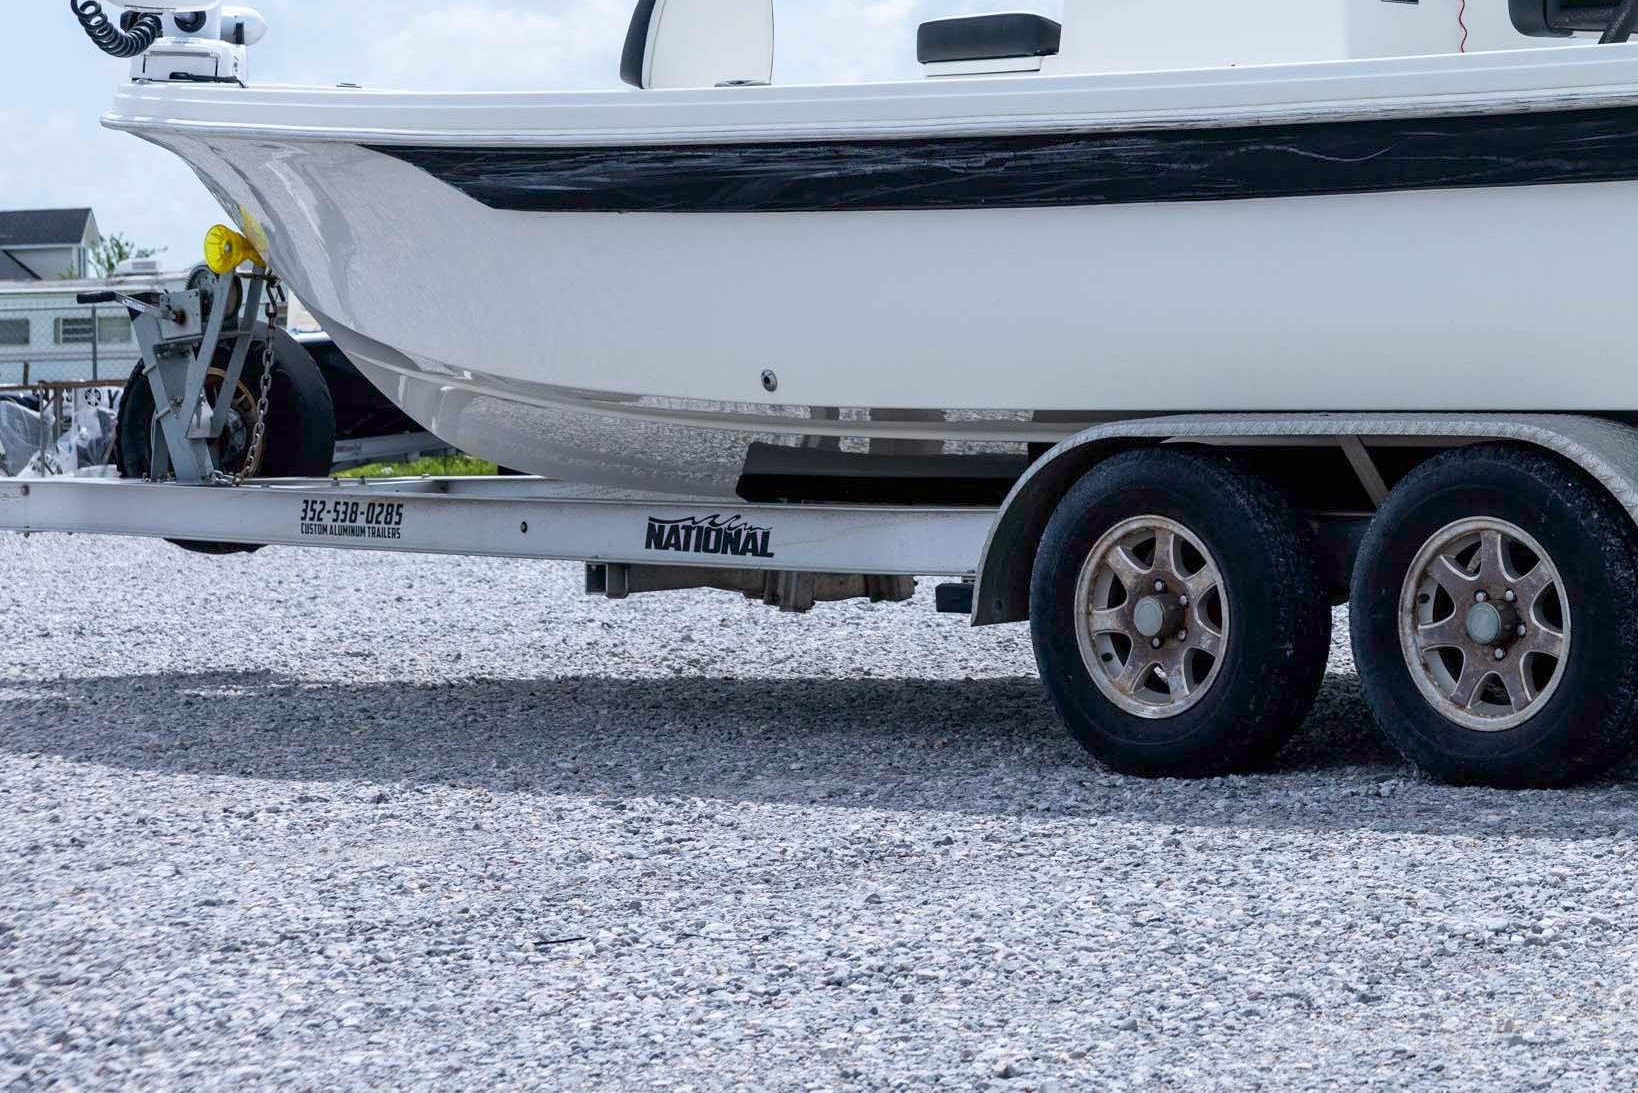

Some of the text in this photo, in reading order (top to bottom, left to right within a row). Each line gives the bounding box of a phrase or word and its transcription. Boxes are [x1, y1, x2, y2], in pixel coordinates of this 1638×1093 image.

[300, 499, 404, 526] 352-538-0285
[300, 522, 401, 539] CUSTOM ALUMINUM TRAILERS
[644, 521, 775, 558] NATIONAL
